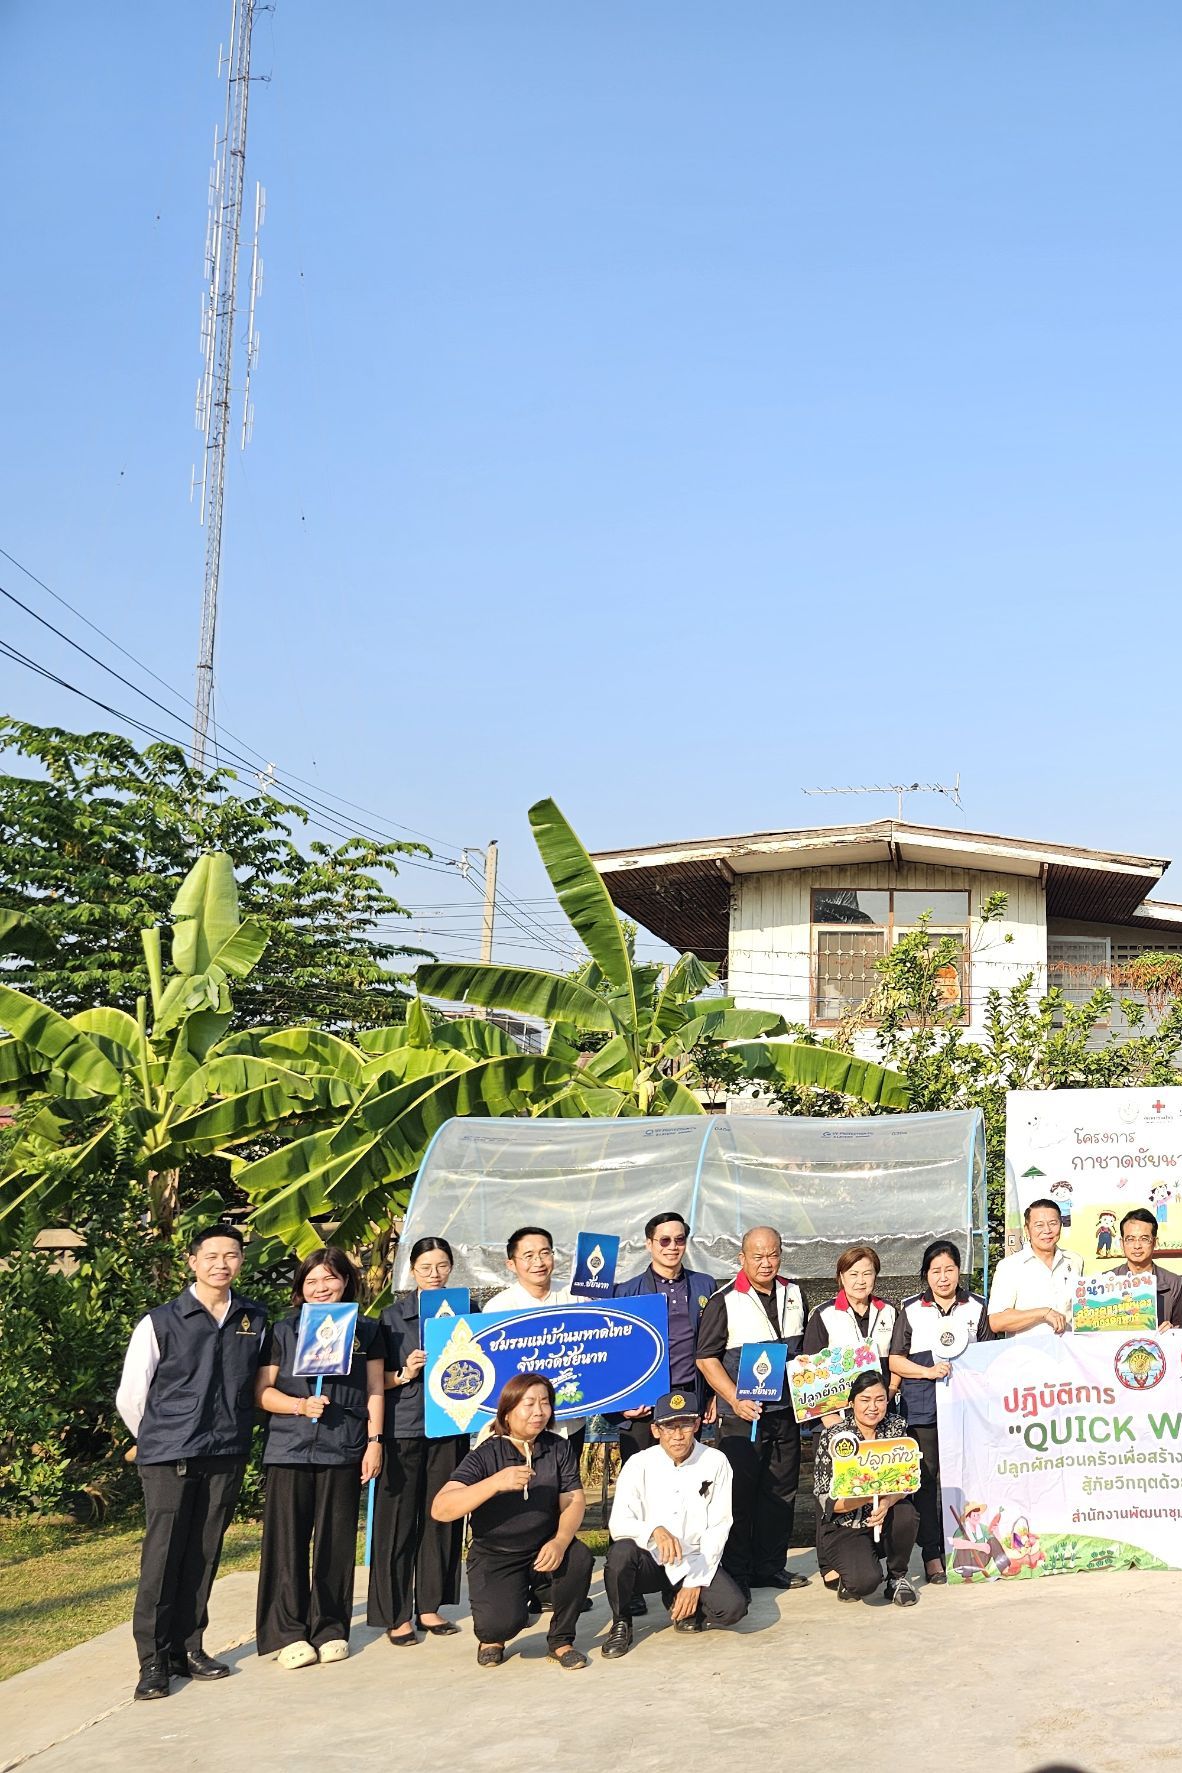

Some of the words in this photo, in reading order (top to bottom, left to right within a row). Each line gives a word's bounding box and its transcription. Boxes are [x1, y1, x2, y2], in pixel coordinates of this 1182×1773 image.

[1073, 1127, 1136, 1144] โครงการ
[489, 1316, 633, 1352] ชมรมแม่บ้านมหาดไทย
[517, 1342, 608, 1372] จังหวัดชัยนาท
[1003, 1382, 1116, 1418] ปฏิบัติการ
[857, 1446, 915, 1472] ปลูกพืช
